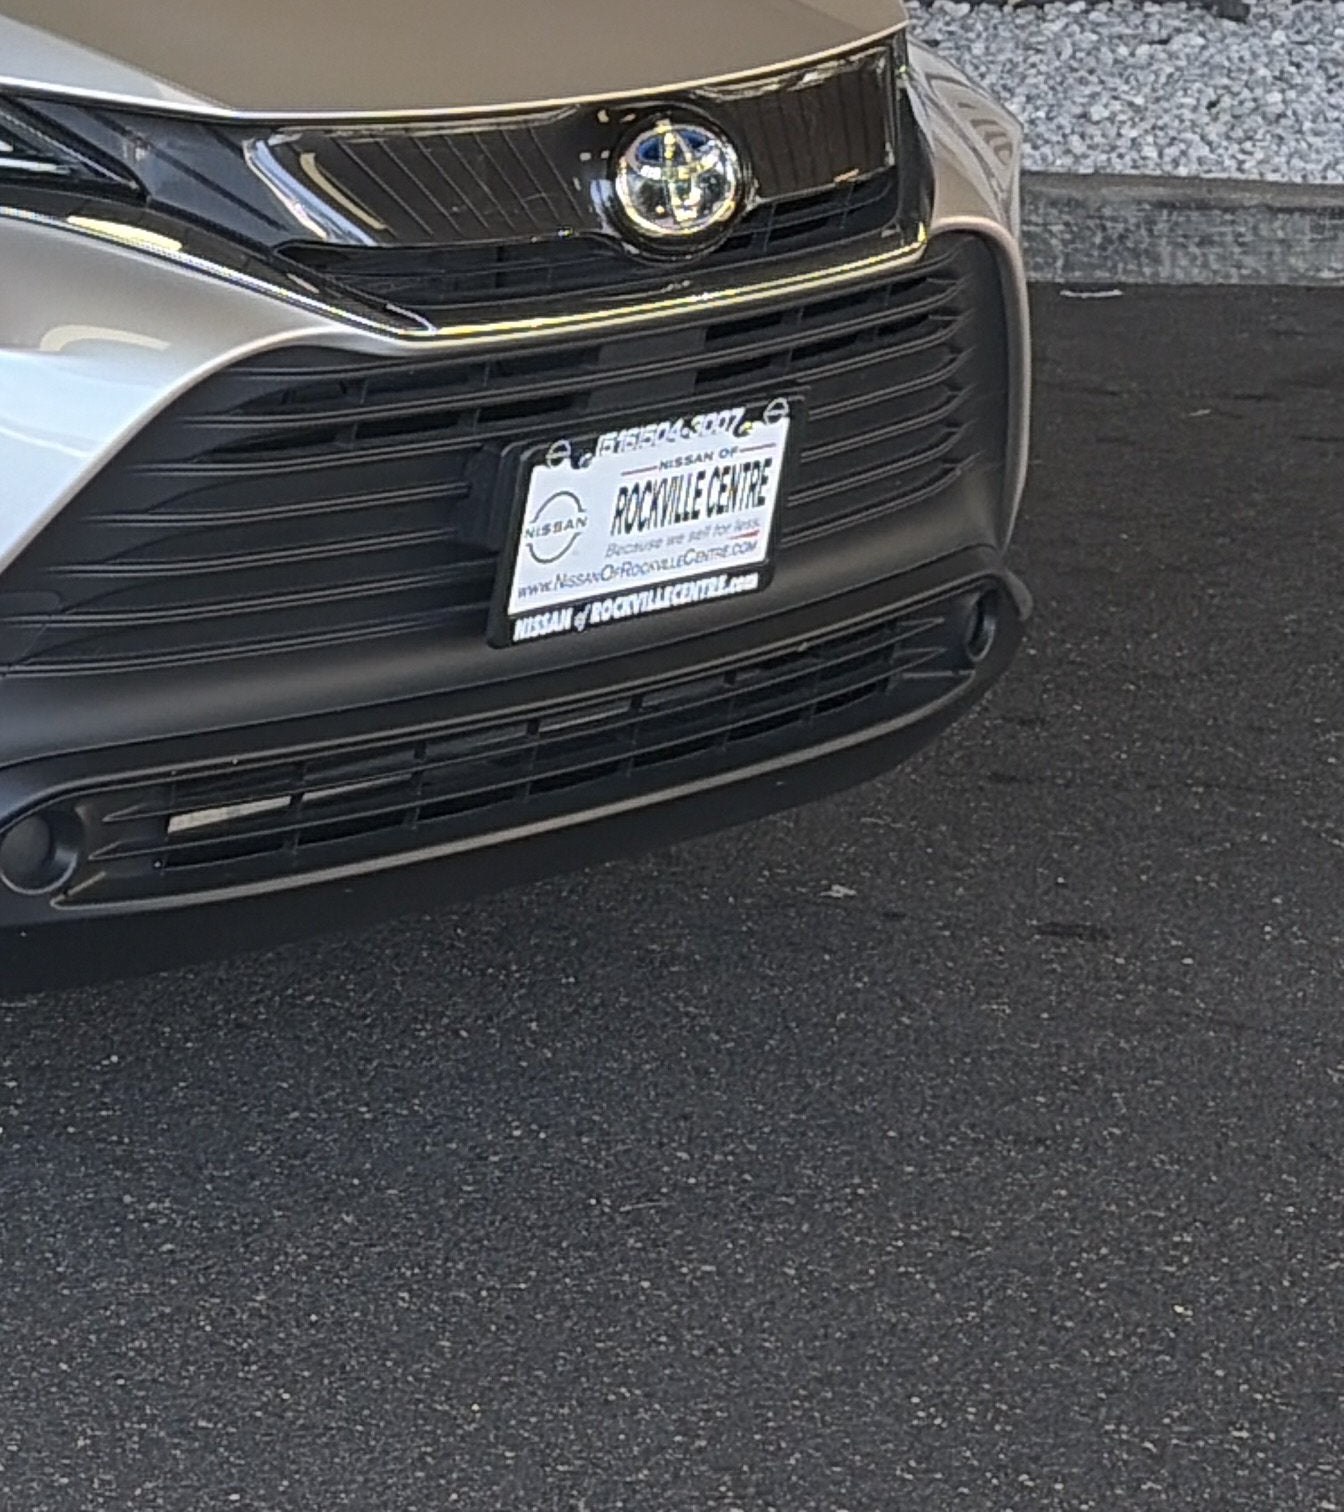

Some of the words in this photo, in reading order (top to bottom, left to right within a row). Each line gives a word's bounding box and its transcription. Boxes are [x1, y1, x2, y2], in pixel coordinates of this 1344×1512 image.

[658, 452, 713, 471] NISSAN
[717, 445, 739, 460] OF
[610, 470, 706, 536] ROCKVILLE
[707, 458, 773, 518] CENTRE
[525, 516, 588, 539] NISSAN
[513, 606, 574, 641] NISSAN
